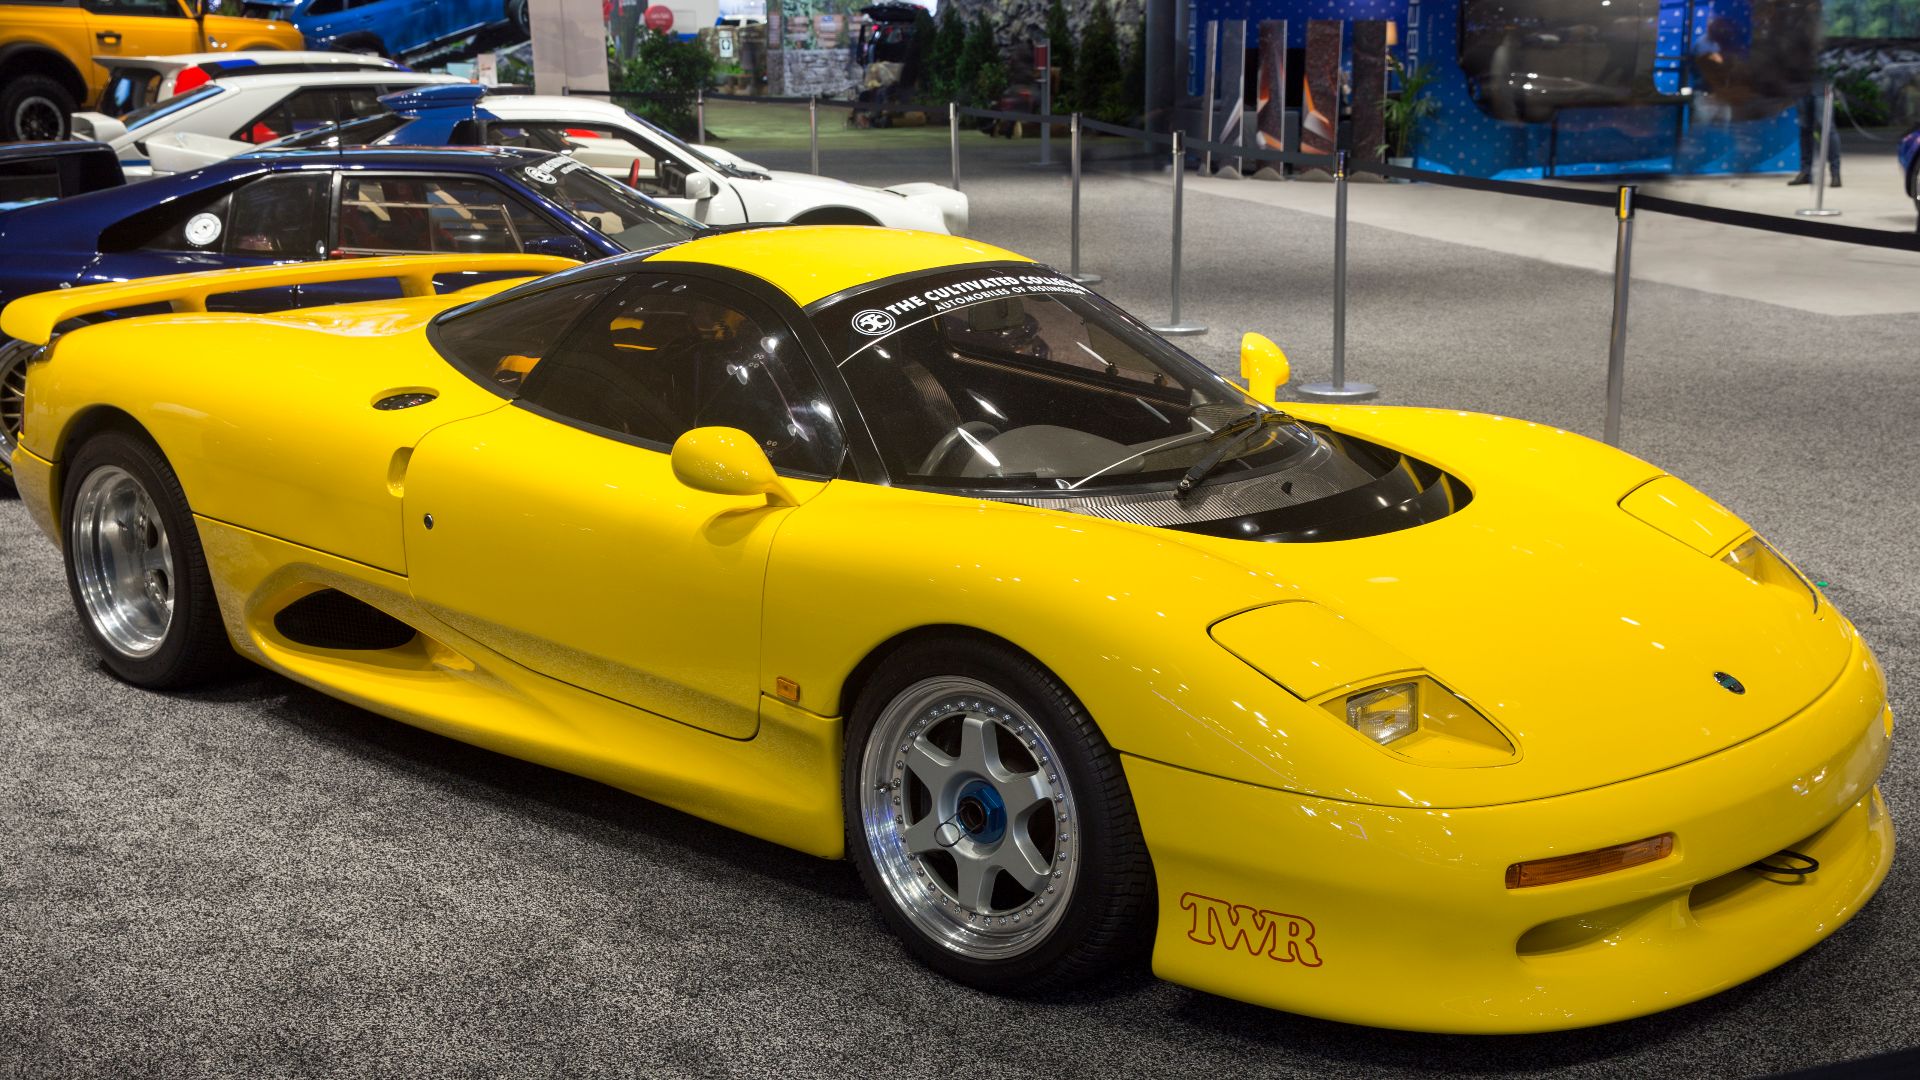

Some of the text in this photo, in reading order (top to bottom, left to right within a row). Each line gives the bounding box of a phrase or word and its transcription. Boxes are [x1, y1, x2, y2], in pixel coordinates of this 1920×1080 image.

[885, 295, 926, 315] THE
[924, 276, 1019, 301] CULTIVATED
[934, 288, 1011, 312] AUTOMOBILES
[1180, 892, 1323, 968] TWR
